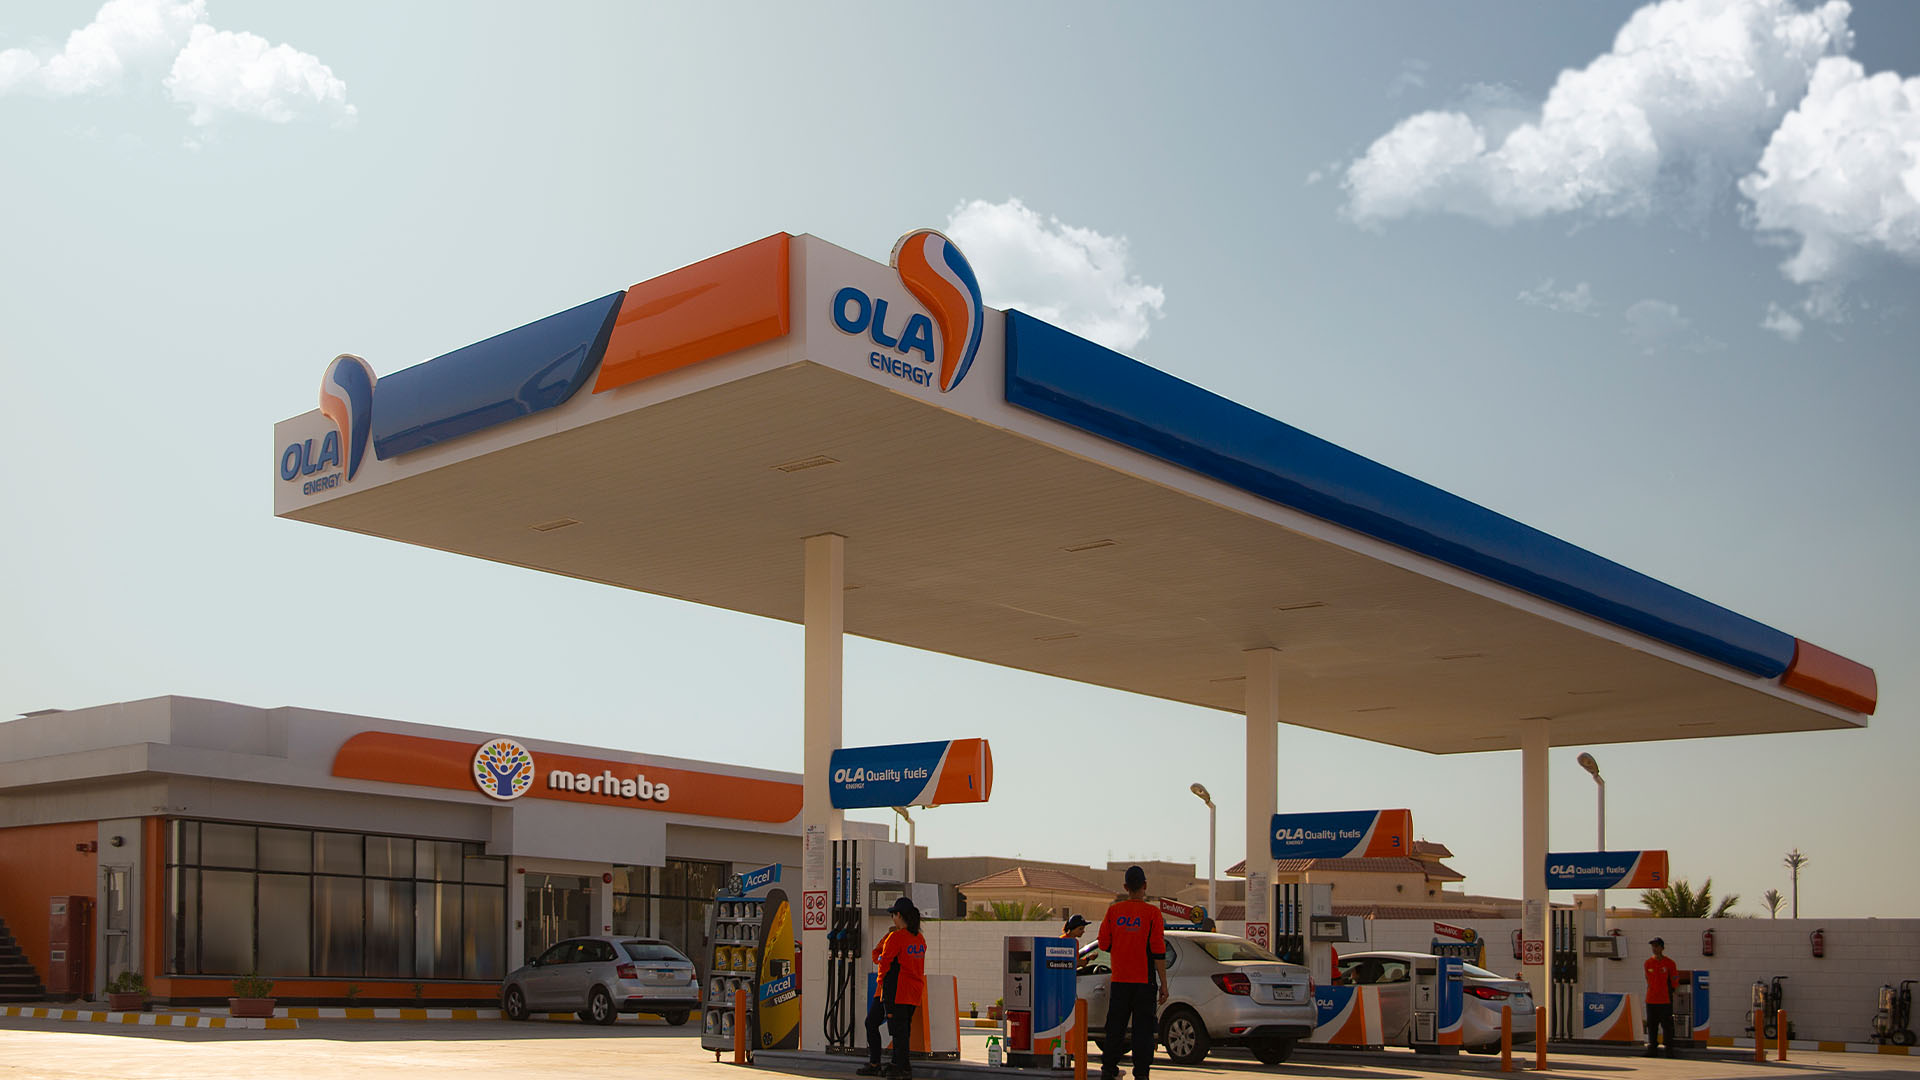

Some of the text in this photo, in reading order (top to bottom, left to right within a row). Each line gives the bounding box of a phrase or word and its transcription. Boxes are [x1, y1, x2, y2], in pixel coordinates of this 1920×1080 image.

[831, 286, 935, 364] OLA
[868, 351, 933, 387] ENERGY
[280, 430, 340, 481] OLA
[303, 472, 342, 495] ENERGY
[834, 767, 928, 783] OLA Quality fuels
[548, 769, 670, 802] marhaba
[845, 782, 865, 790] ENERGY
[1275, 828, 1361, 841] OLA Quality fuels
[1391, 835, 1401, 848] 3
[1549, 865, 1626, 876] OLA Quality fuels
[1651, 871, 1661, 881] 5
[745, 869, 770, 888] Accel
[1116, 916, 1141, 928] OLA
[907, 944, 925, 955] OLA
[766, 976, 791, 996] Accel
[774, 990, 797, 1005] FUSION
